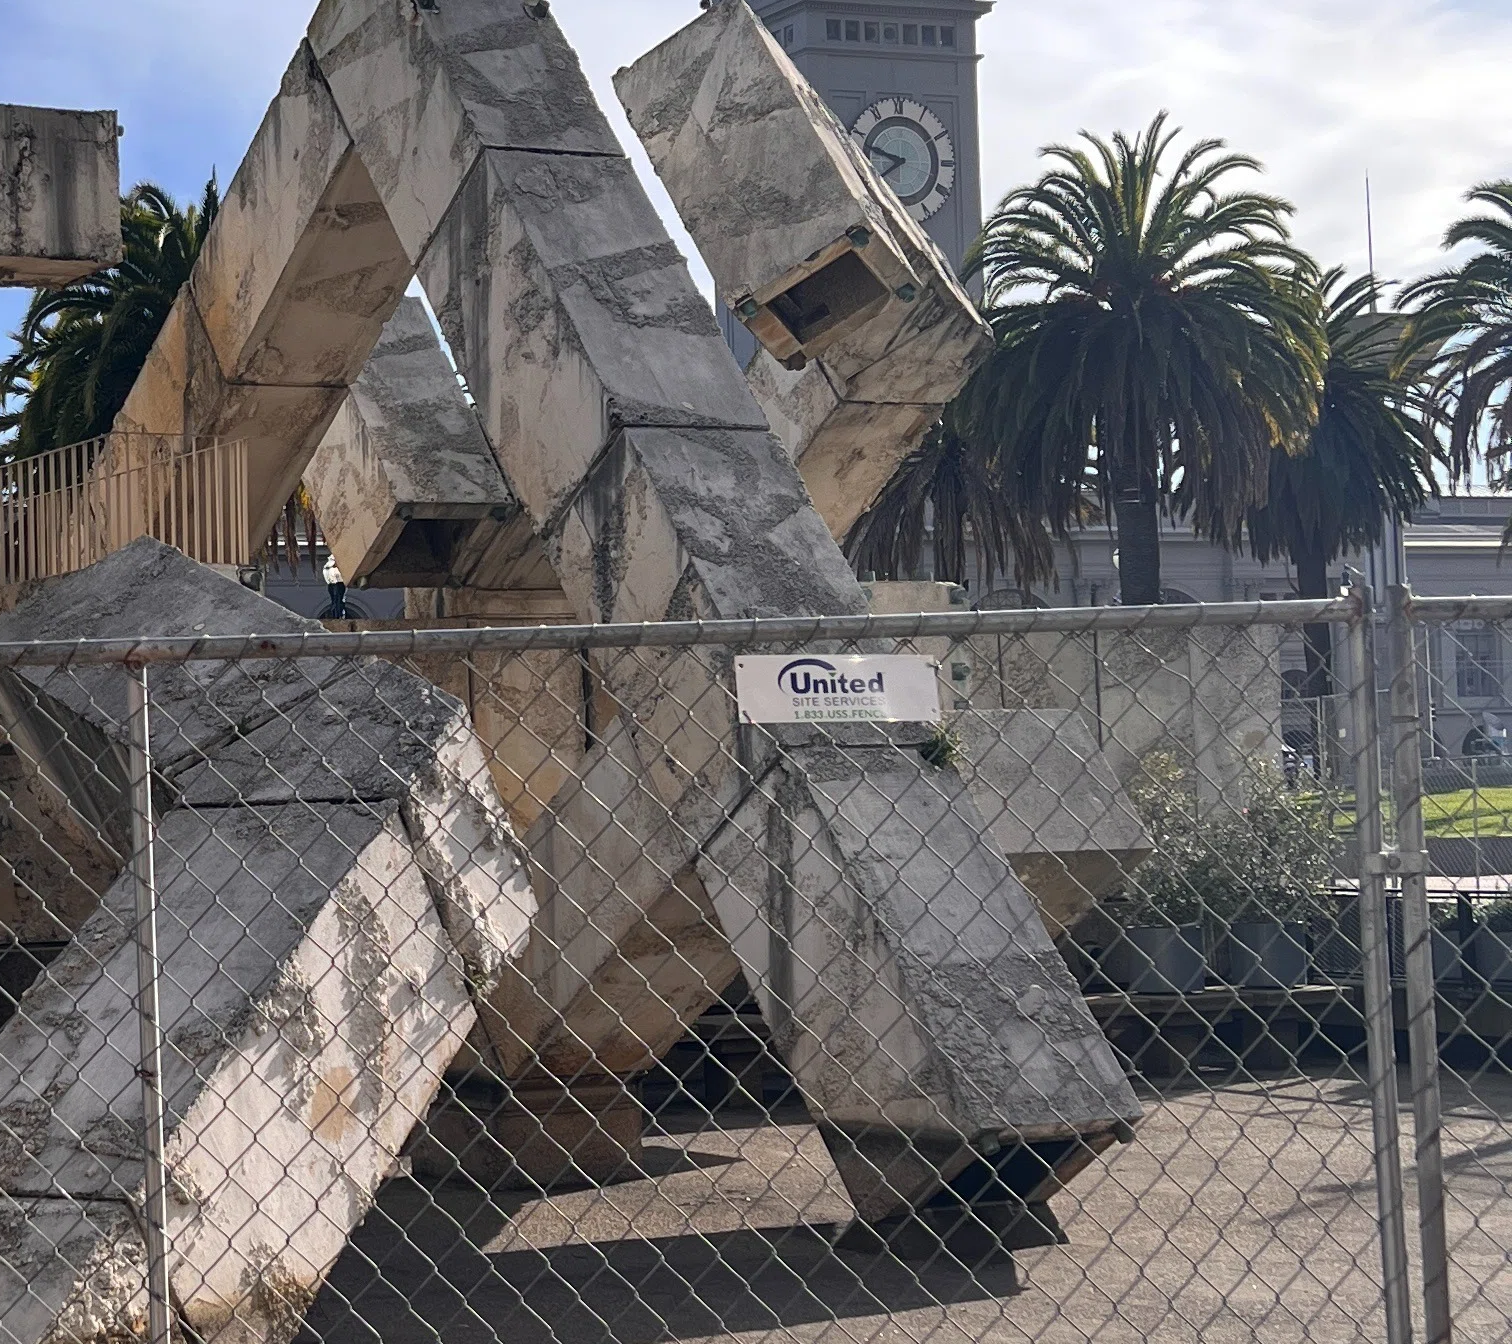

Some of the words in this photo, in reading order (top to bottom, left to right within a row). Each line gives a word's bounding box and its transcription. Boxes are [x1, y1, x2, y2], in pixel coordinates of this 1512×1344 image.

[790, 671, 885, 694] United
[792, 697, 820, 707] SITE
[824, 696, 886, 707] SERVICES
